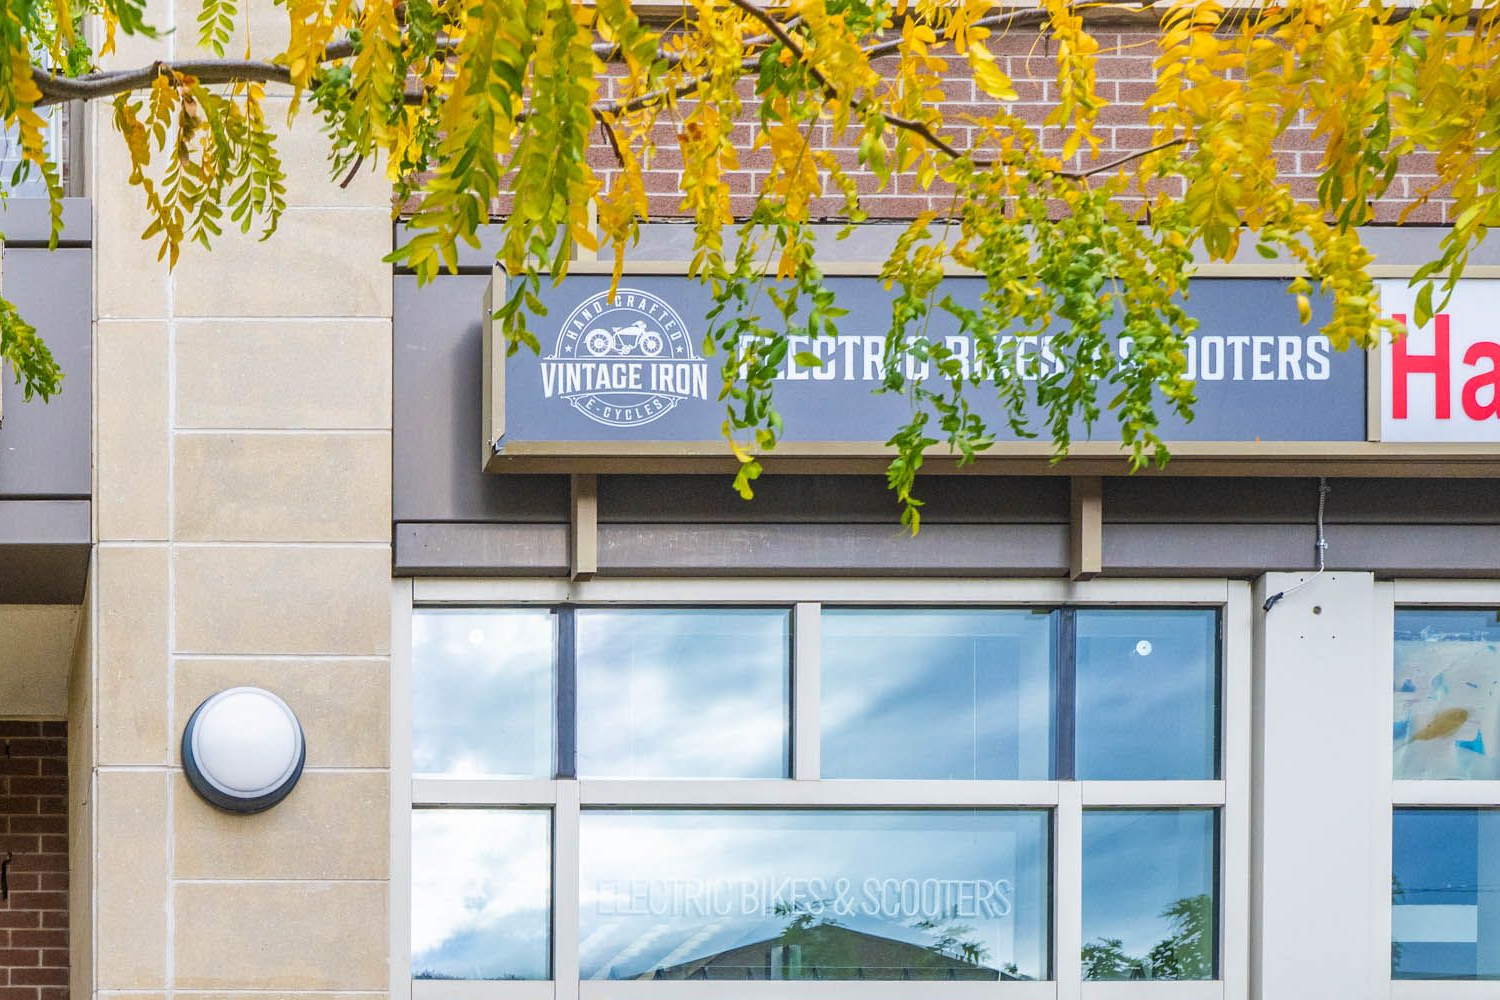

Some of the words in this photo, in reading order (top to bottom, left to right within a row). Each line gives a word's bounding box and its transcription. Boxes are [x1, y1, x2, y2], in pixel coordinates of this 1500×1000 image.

[566, 295, 682, 340] HAND-CRAFTED
[739, 335, 930, 380] EECTRC
[1118, 335, 1330, 380] OOTERS
[540, 363, 643, 398] VINTAGE
[651, 363, 708, 400] IRON
[585, 399, 662, 420] E-CYCLES
[597, 880, 732, 916] ELECTRIC
[740, 878, 825, 916] BIKES
[832, 878, 855, 917] &
[863, 878, 1013, 917] SCOOTERS
